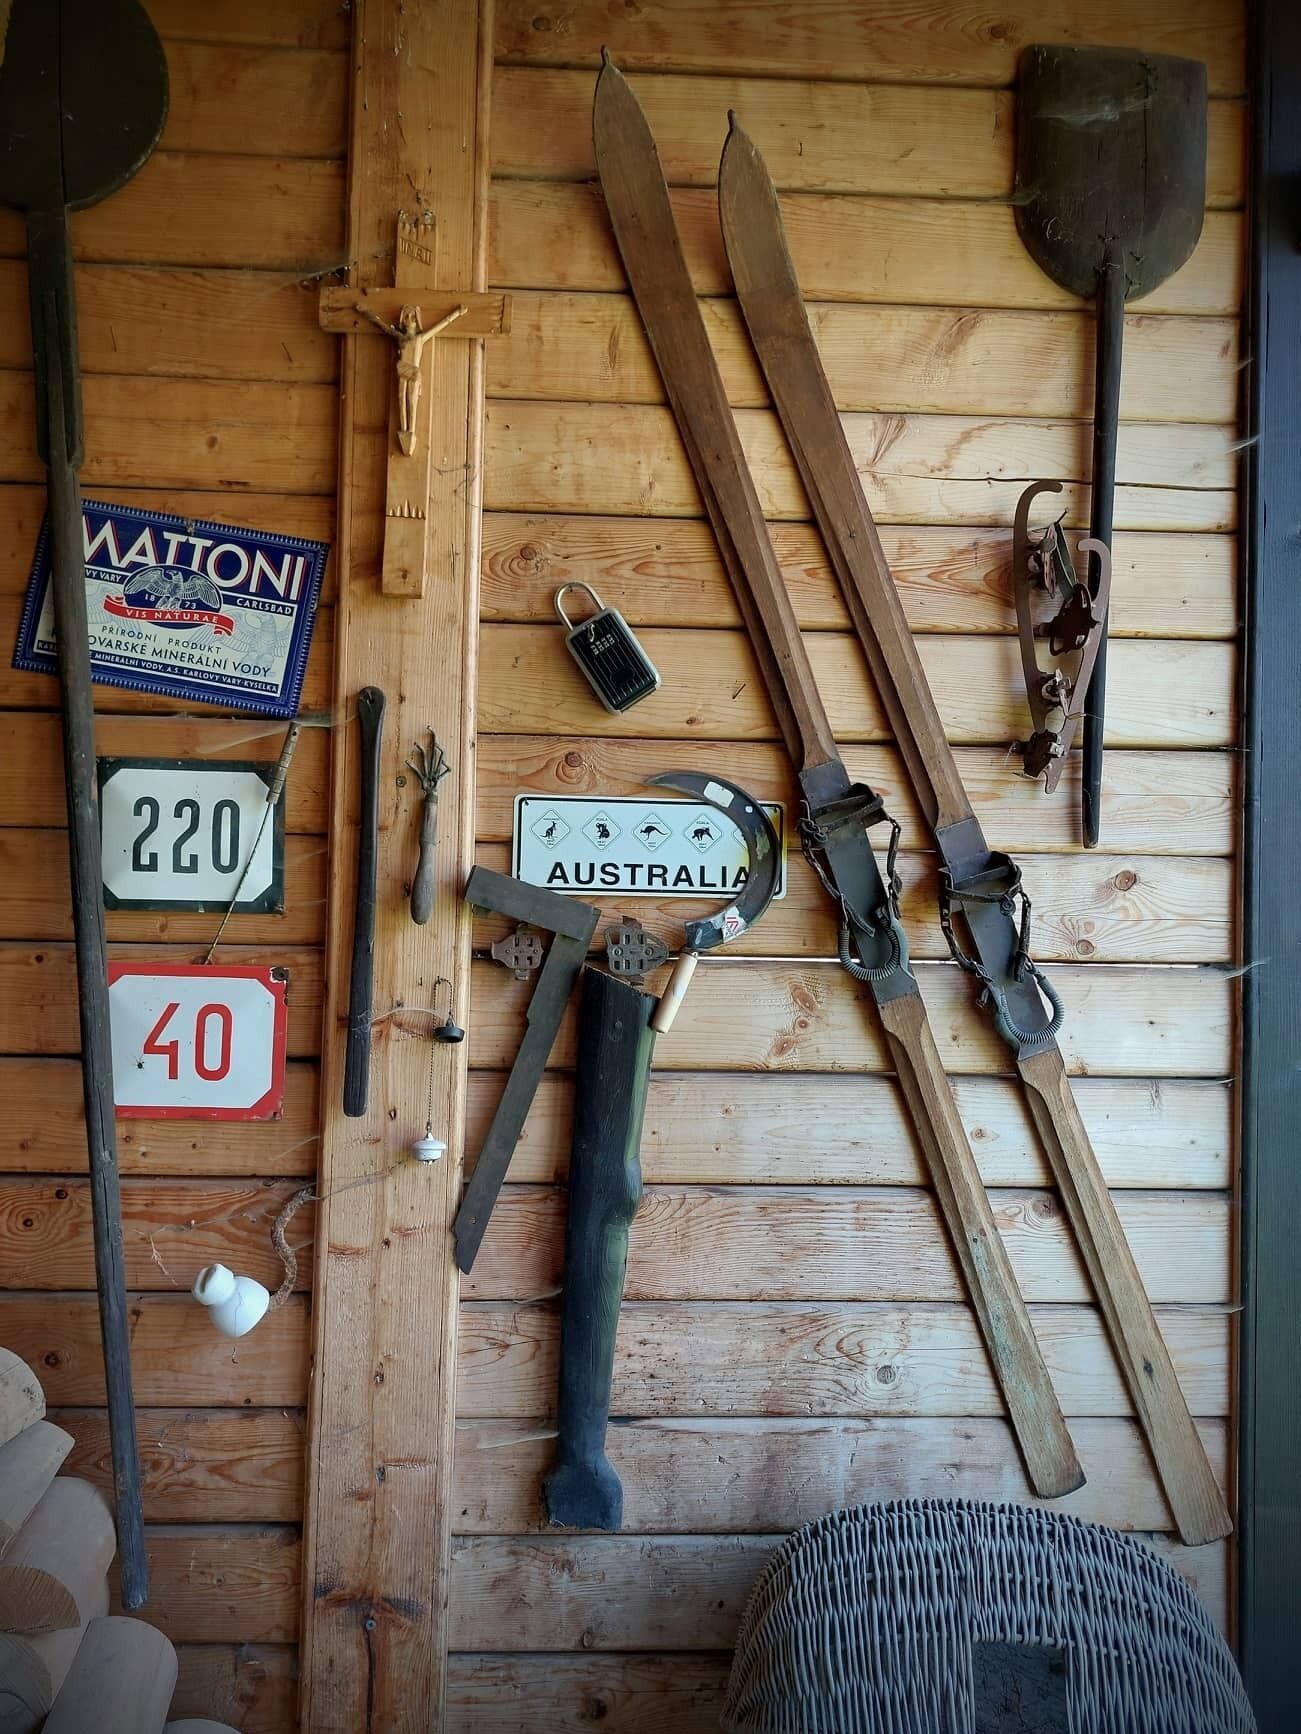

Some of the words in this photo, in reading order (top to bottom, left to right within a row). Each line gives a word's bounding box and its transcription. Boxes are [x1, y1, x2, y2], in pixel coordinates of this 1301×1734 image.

[82, 516, 304, 600] MATTONI
[144, 593, 156, 602] 18
[236, 598, 292, 615] CARLSBAD
[126, 609, 148, 618] VIS
[154, 612, 219, 624] NATURAE
[167, 638, 222, 655] PRODUKT
[151, 645, 228, 671] MINERÁLNÍ
[232, 661, 272, 678] VODY
[132, 796, 241, 874] 220
[547, 861, 750, 889] AUSTRALIA
[143, 1002, 233, 1082] 40
